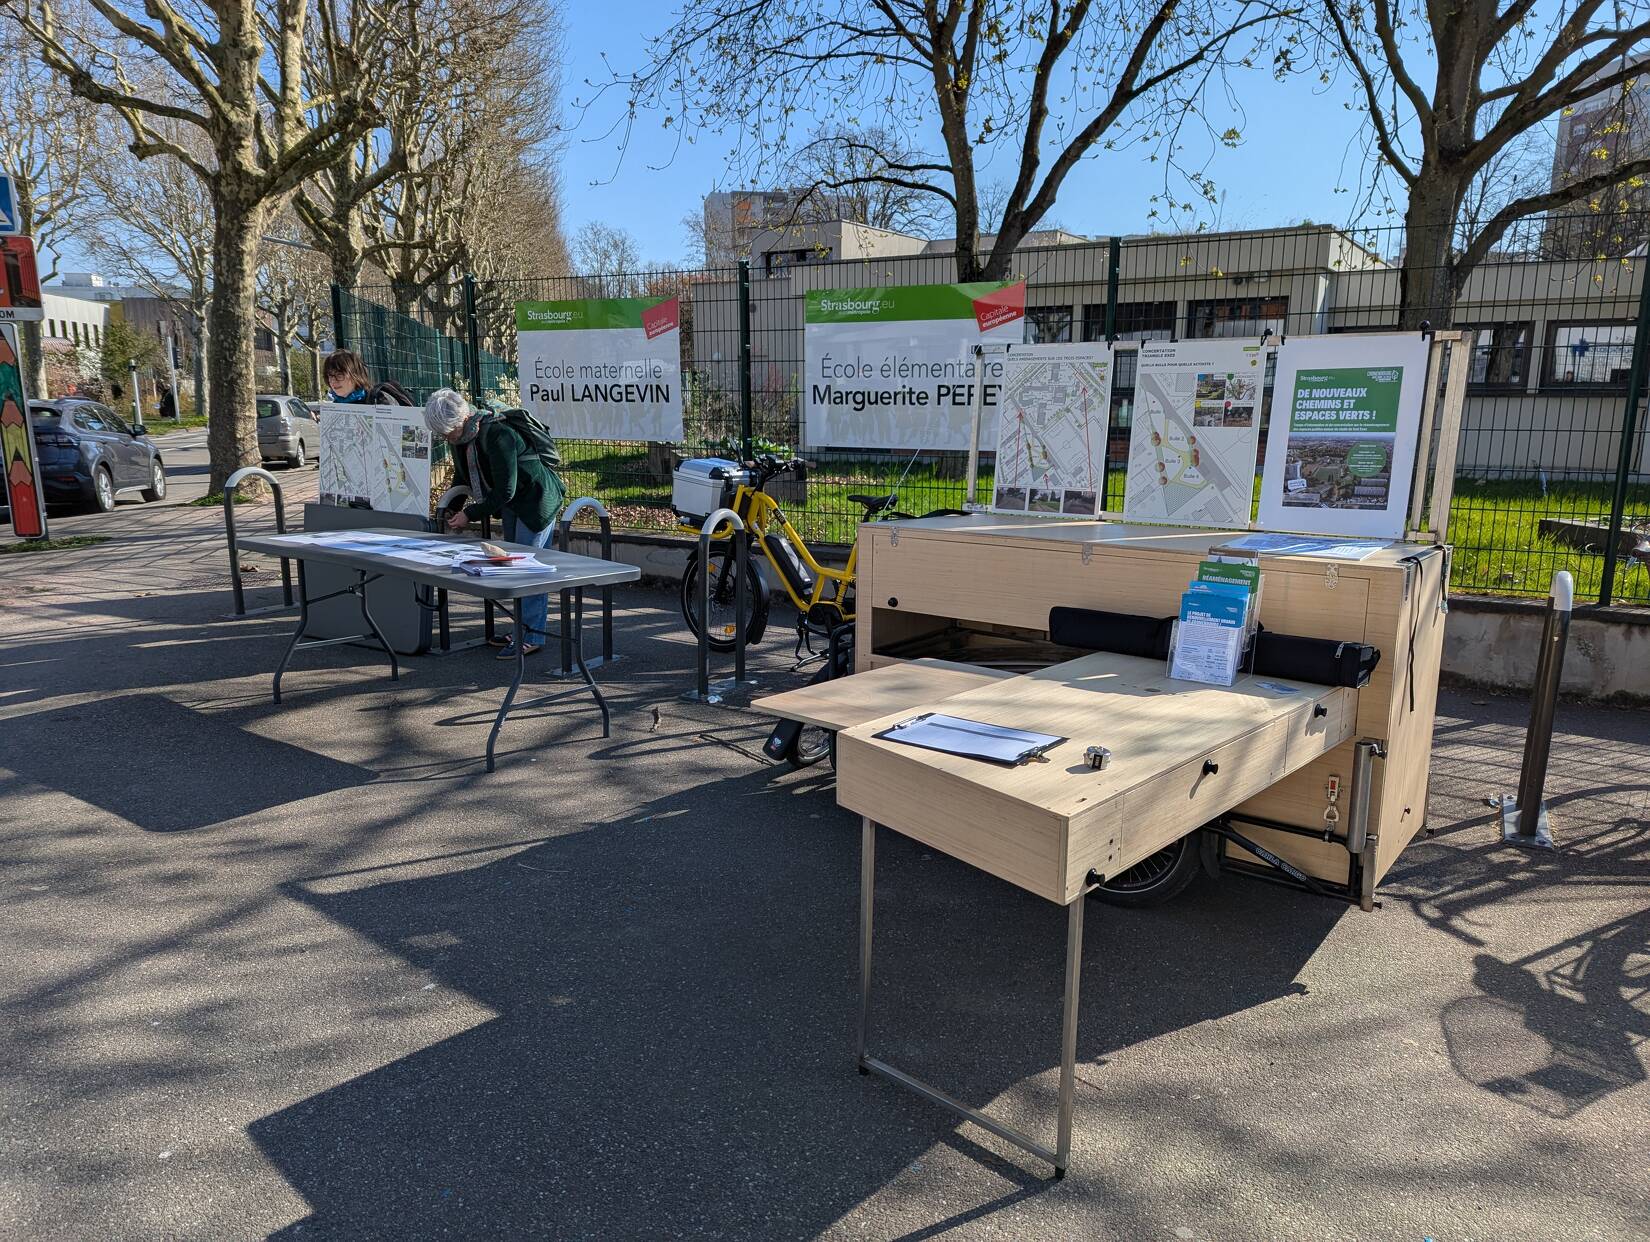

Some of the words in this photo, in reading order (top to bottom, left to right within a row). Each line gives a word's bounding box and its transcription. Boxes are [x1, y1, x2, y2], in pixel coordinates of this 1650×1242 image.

[821, 298, 894, 314] Strasbourg.eu
[980, 303, 1008, 320] Capitale
[527, 309, 584, 321] Strasbourg.eu
[982, 311, 1017, 327] européenne
[534, 356, 574, 379] École
[580, 358, 662, 379] maternelle
[821, 352, 873, 379] École
[880, 355, 1003, 379] élémentare
[530, 383, 565, 402] Paul
[571, 384, 670, 403] LANGEVIN
[812, 384, 929, 412] Marguerite
[1297, 388, 1310, 398] DE
[1312, 387, 1368, 398] NOUVEAUX
[1296, 400, 1342, 409] CHEMINS
[1343, 399, 1356, 409] ET
[1294, 411, 1337, 420] ESPACES
[1339, 410, 1370, 420] VERTS
[1372, 410, 1376, 420] !
[1280, 862, 1306, 881] CARGO
